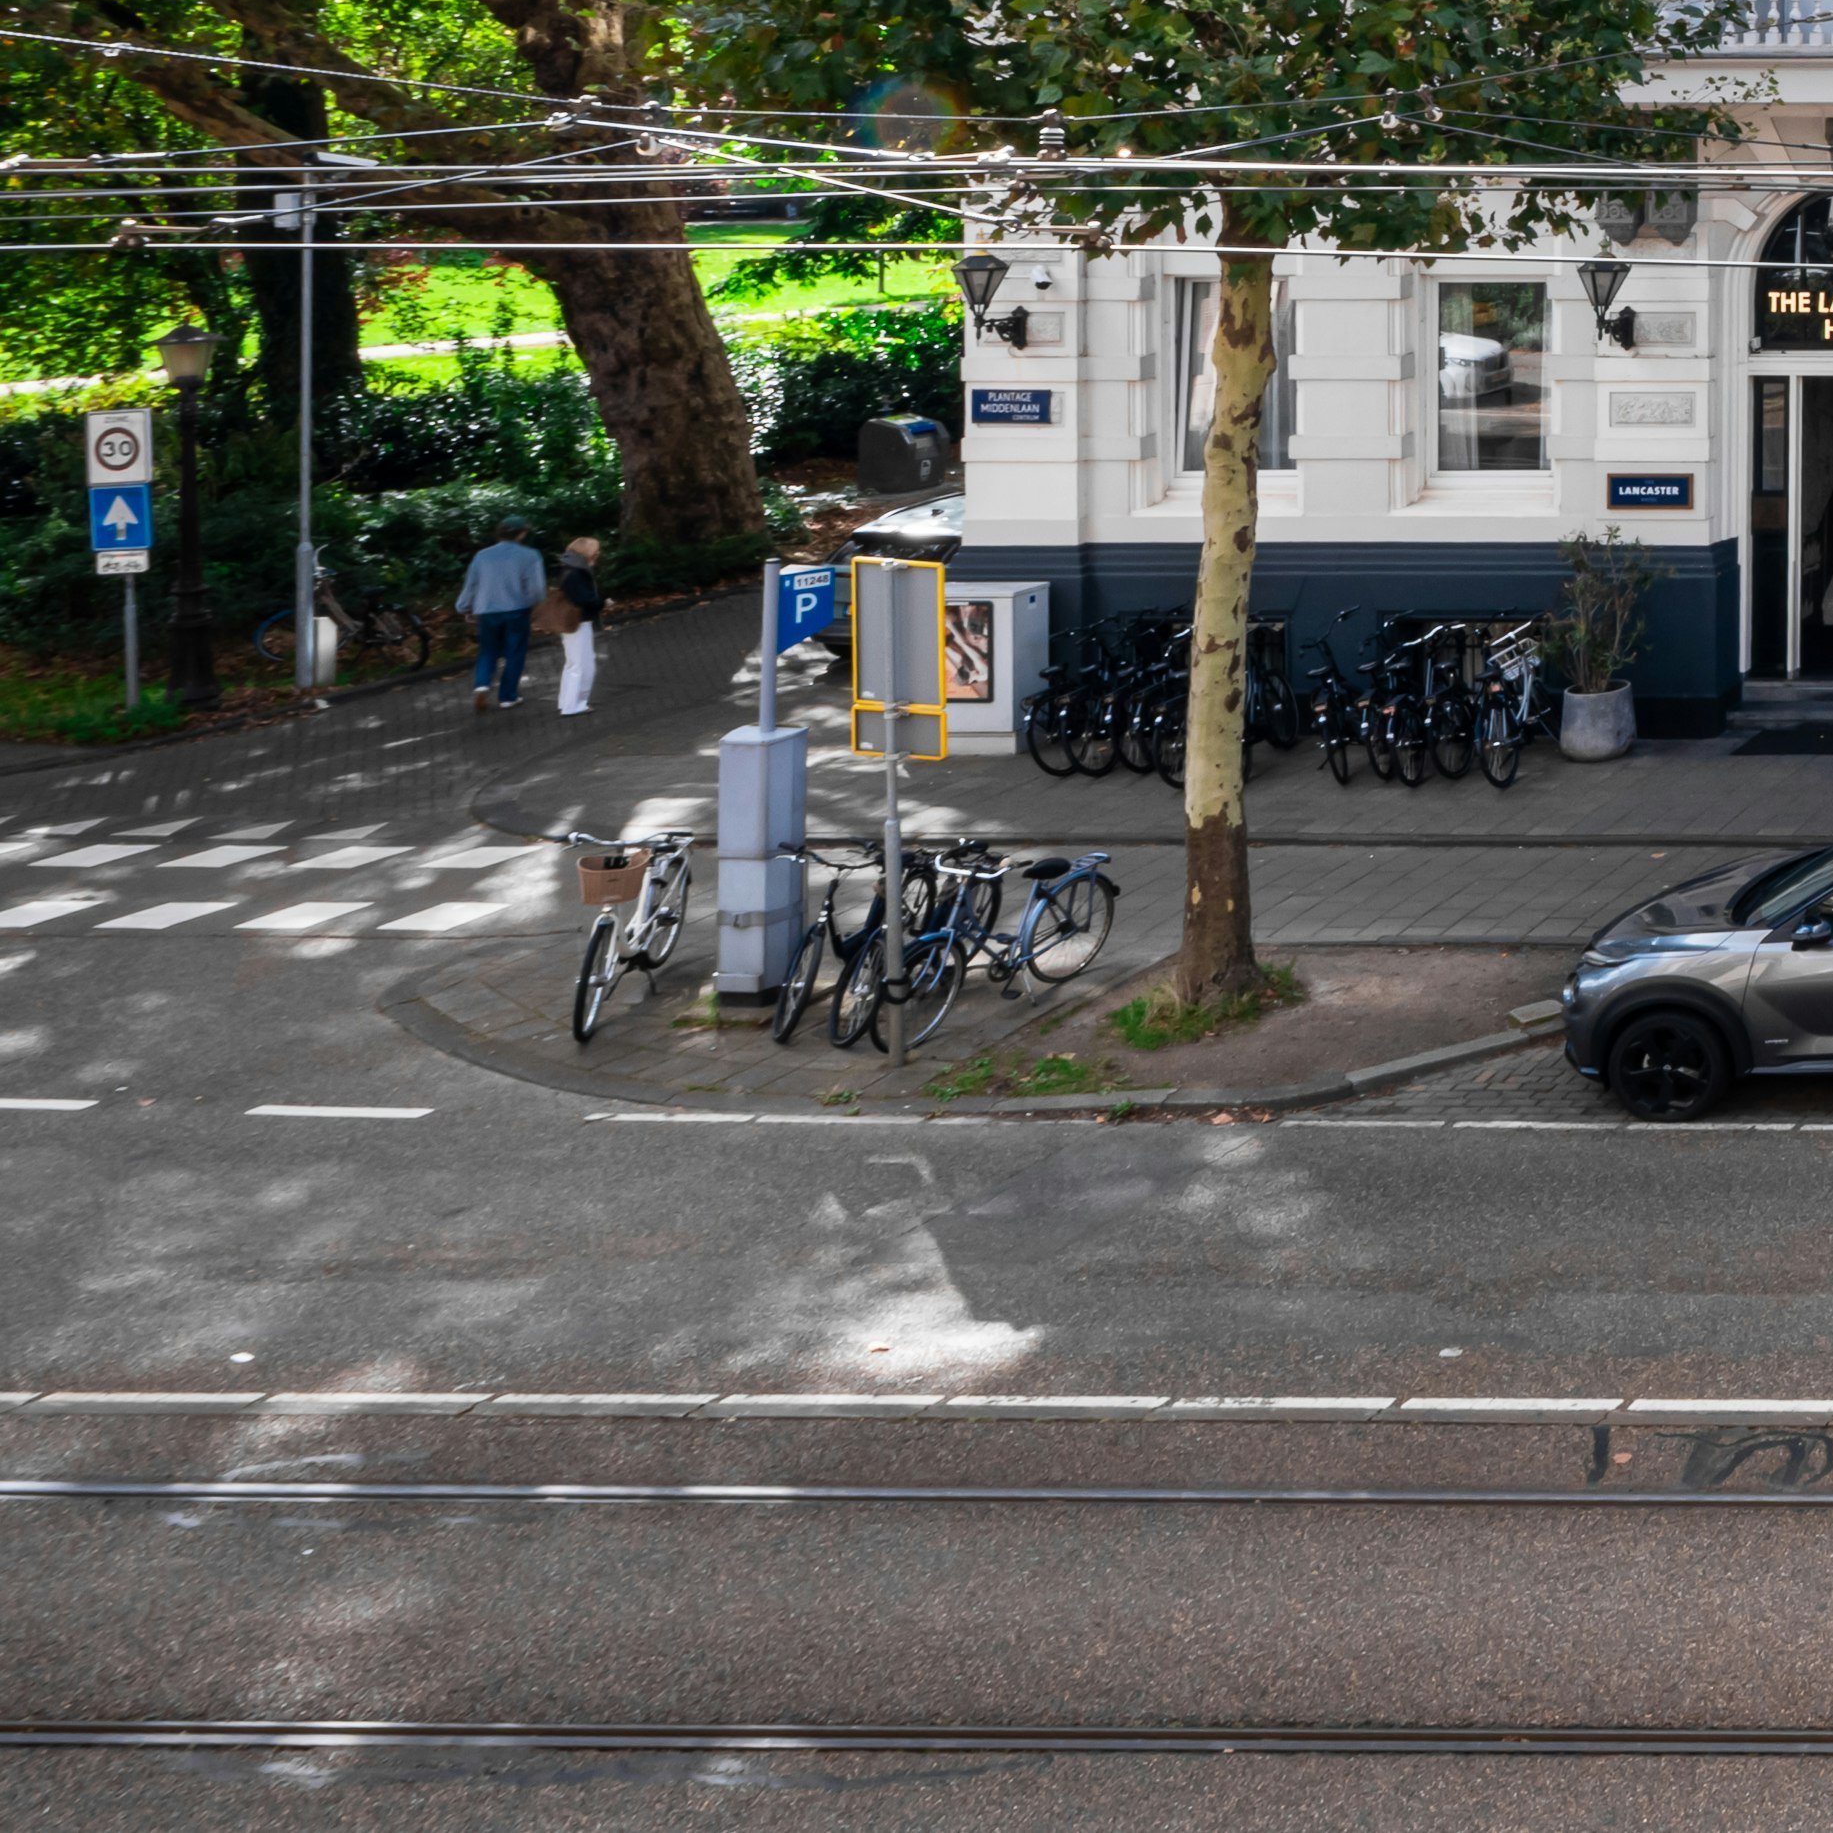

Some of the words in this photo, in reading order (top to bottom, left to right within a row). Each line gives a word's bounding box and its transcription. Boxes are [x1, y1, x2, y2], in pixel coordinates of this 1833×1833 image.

[1767, 291, 1811, 314] THE
[987, 392, 1032, 402] PLANTAGE
[980, 403, 1040, 413] MIDDENLAAN
[102, 440, 134, 458] 30
[1618, 486, 1680, 496] LANCASTER
[797, 574, 829, 587] 11248
[795, 592, 818, 623] P
